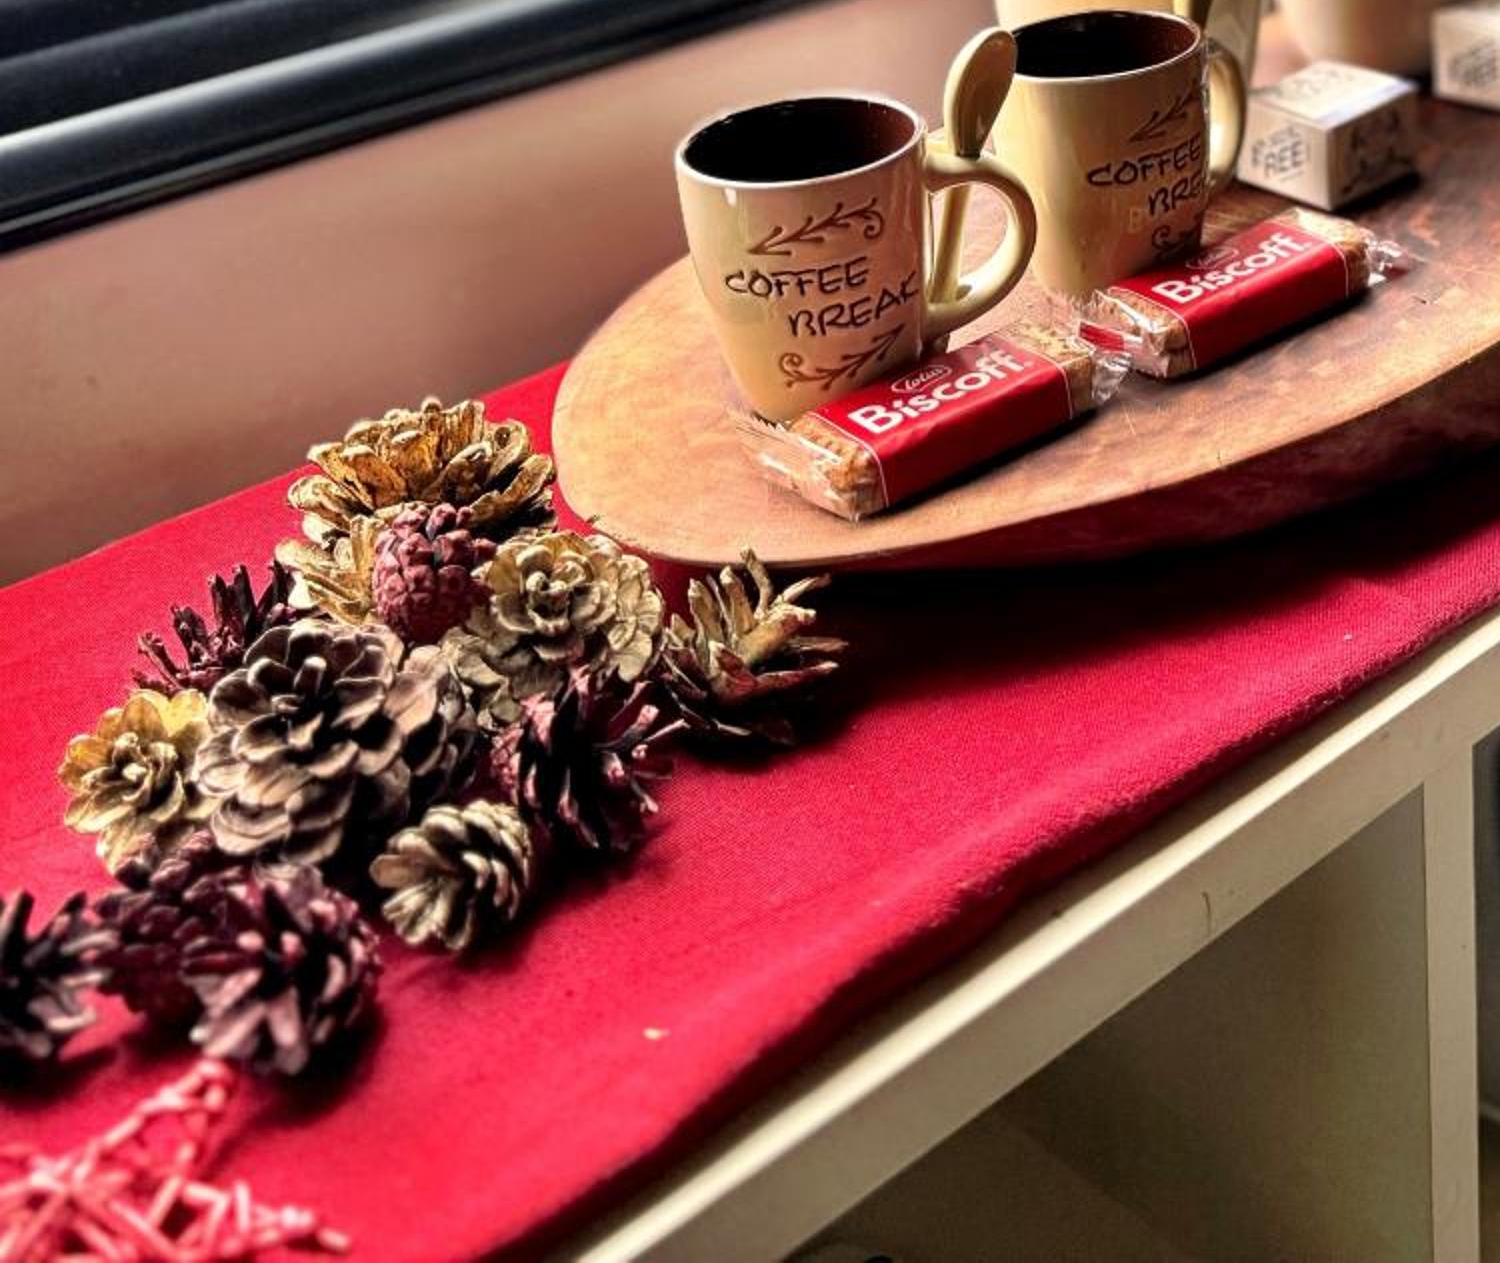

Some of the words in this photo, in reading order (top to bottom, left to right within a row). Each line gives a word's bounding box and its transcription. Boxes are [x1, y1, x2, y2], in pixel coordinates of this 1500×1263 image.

[724, 256, 870, 298] COFFEE
[1151, 231, 1307, 304] Biscoff
[787, 270, 920, 338] BREAK
[847, 349, 1026, 434] Biscoff
